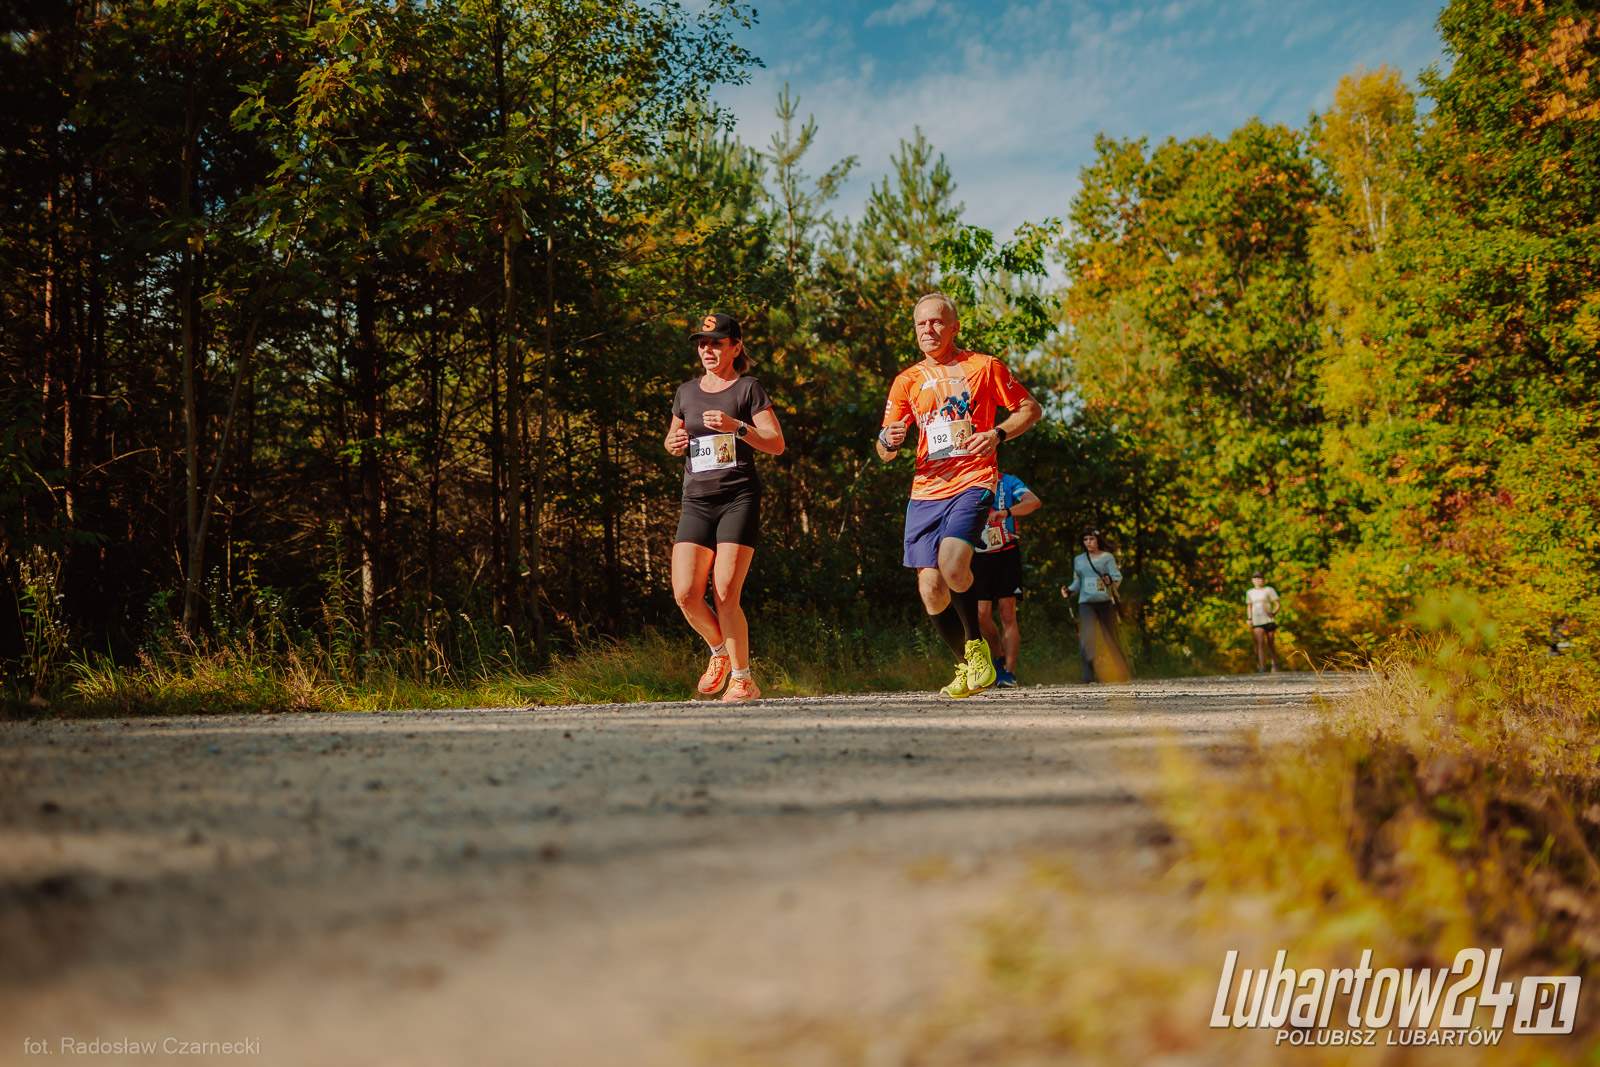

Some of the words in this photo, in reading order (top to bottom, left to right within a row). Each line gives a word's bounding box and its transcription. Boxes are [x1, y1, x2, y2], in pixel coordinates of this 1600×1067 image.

[702, 316, 717, 332] S
[932, 433, 948, 444] 192
[695, 447, 711, 457] 230
